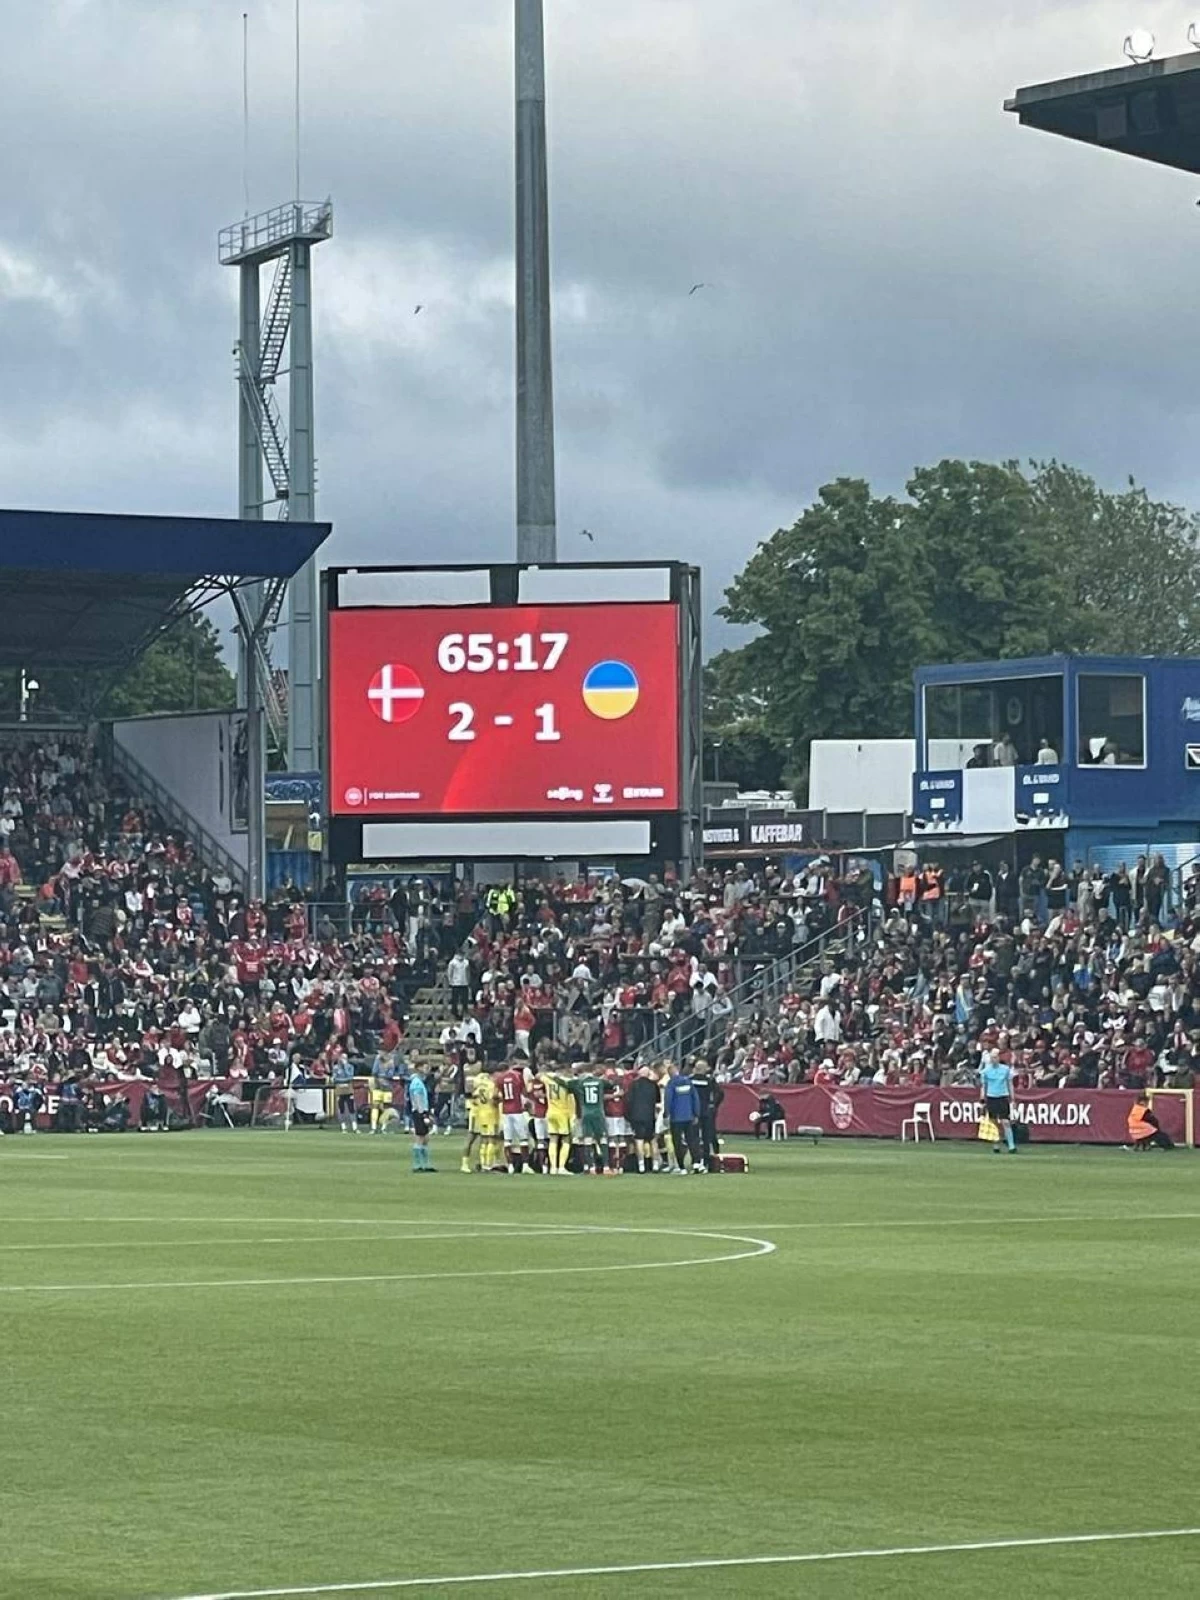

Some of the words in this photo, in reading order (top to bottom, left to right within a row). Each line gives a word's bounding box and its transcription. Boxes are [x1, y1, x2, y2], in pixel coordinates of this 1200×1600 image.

[437, 633, 569, 673] 65:17
[448, 703, 475, 741] 2
[535, 704, 561, 741] 1
[751, 823, 803, 844] KAFFEBAR
[503, 1083, 514, 1100] 11
[584, 1087, 598, 1104] 16
[939, 1101, 1091, 1125] FORDMARK.DK
